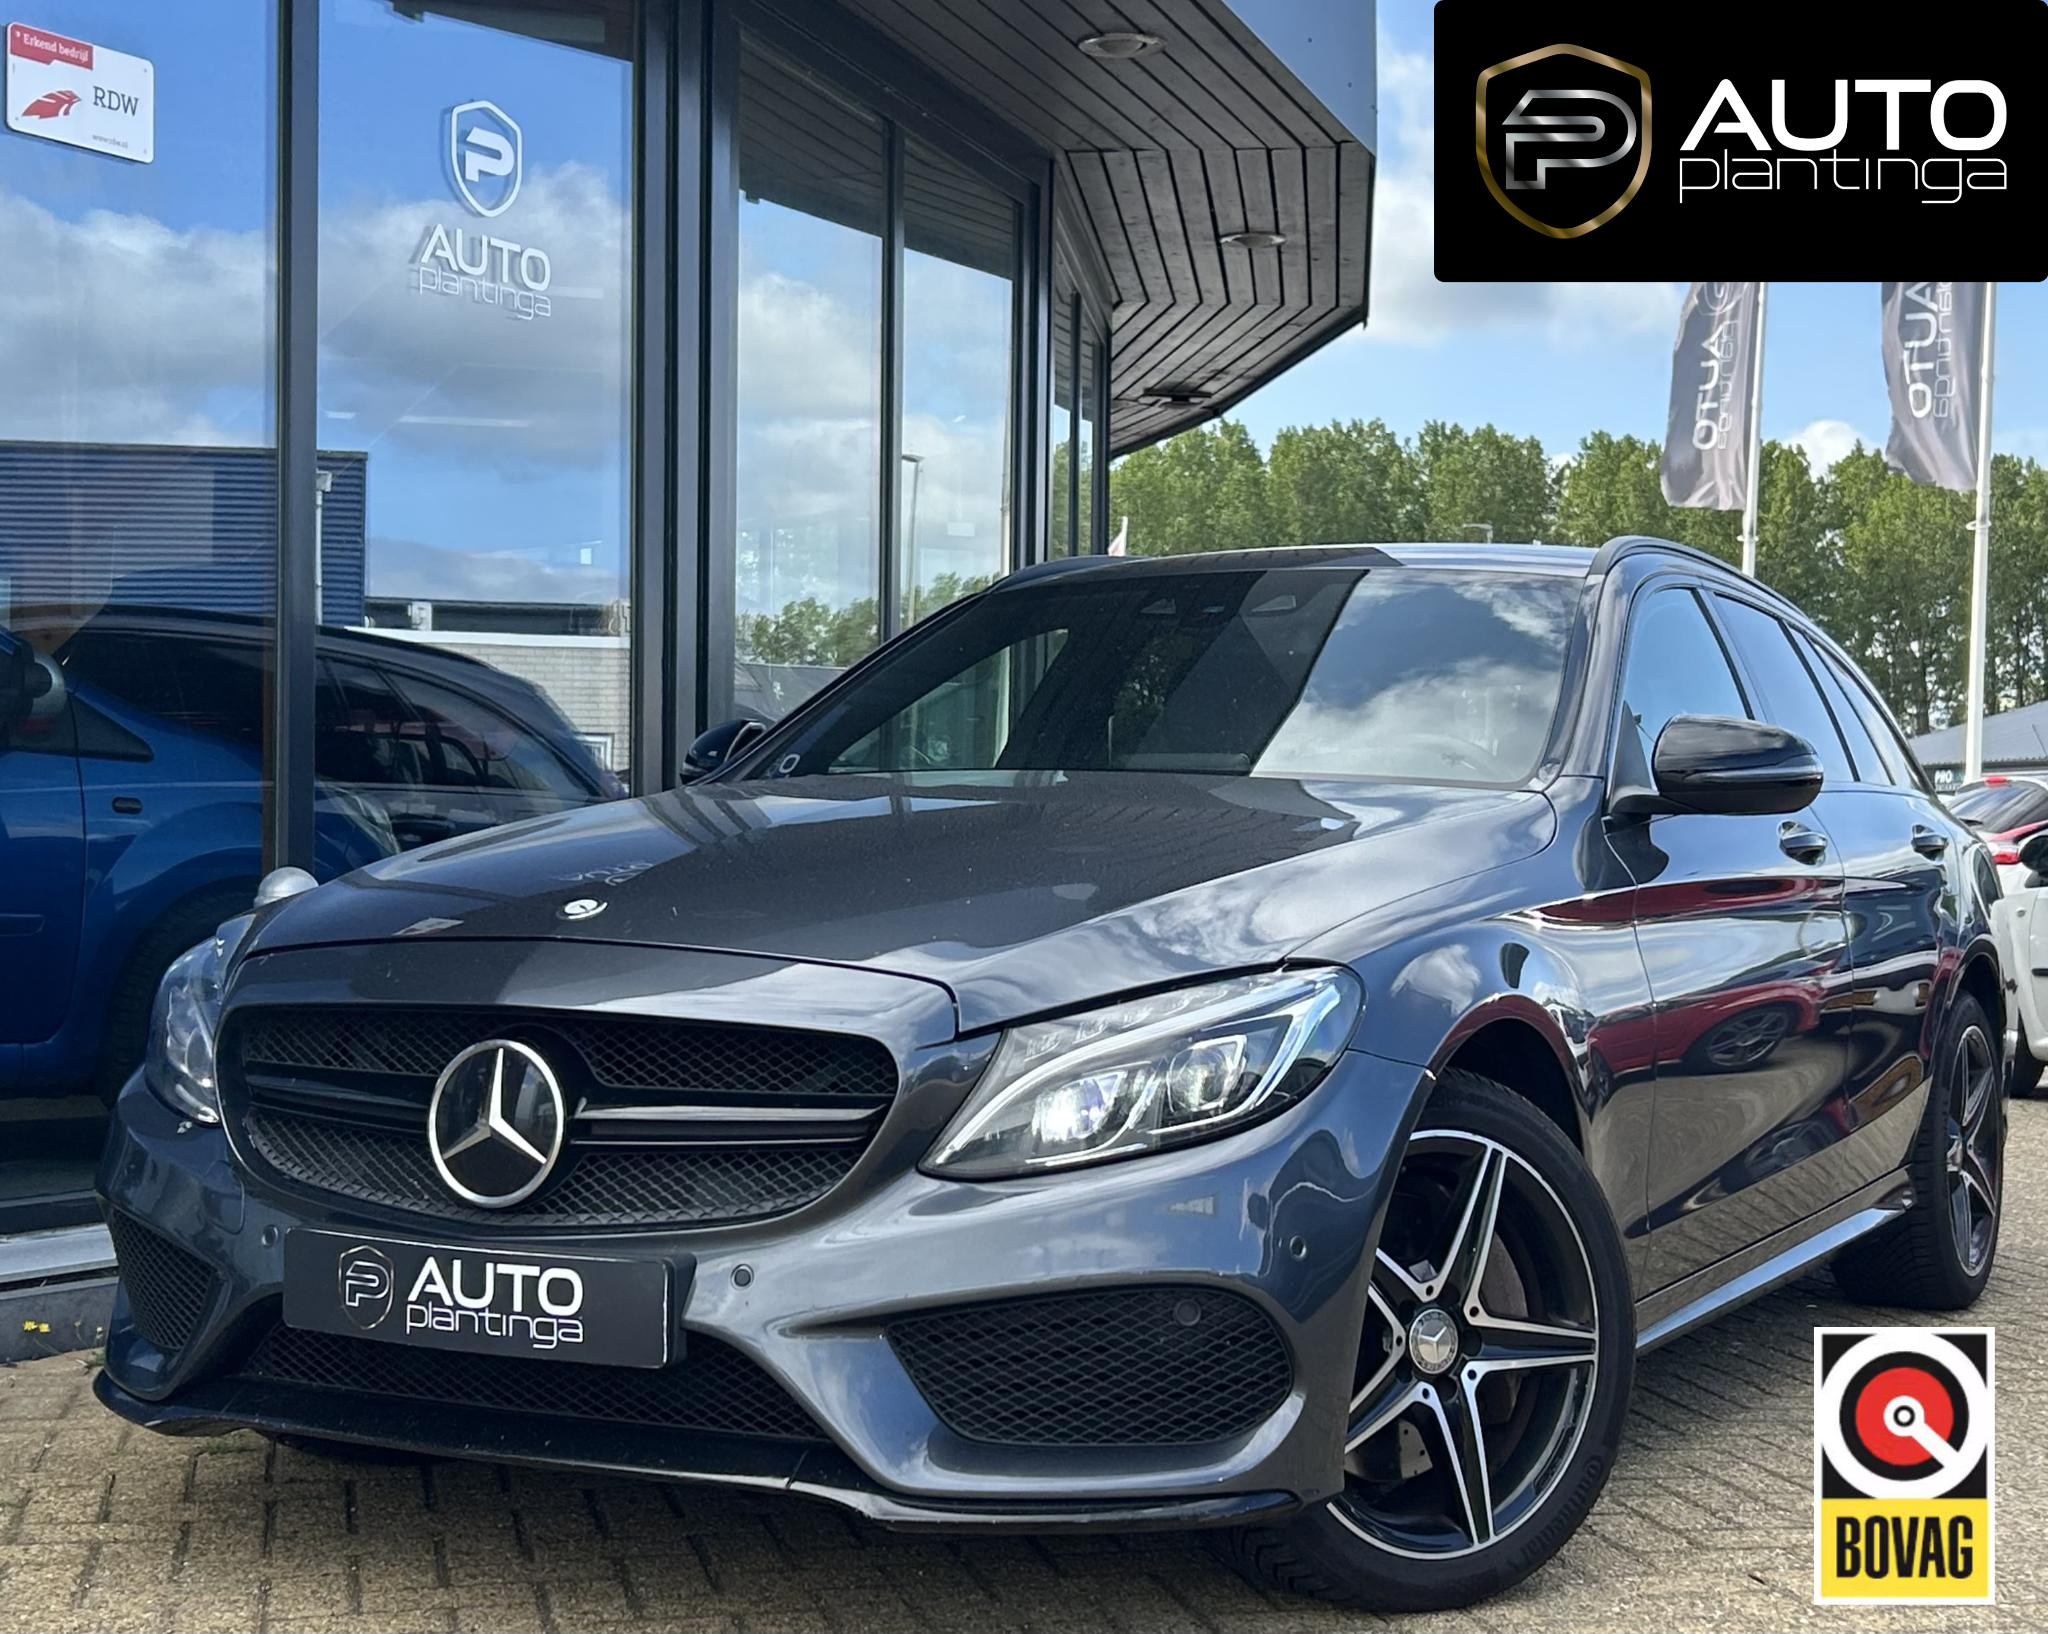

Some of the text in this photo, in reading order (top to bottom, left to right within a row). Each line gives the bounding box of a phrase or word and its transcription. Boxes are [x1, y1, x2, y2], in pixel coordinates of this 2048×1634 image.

[23, 33, 58, 53] Erkend
[93, 85, 139, 117] RDW
[420, 223, 551, 292] AUTO
[419, 266, 552, 321] plantinga
[407, 1256, 585, 1317] AUTO
[406, 1300, 584, 1350] plantinga
